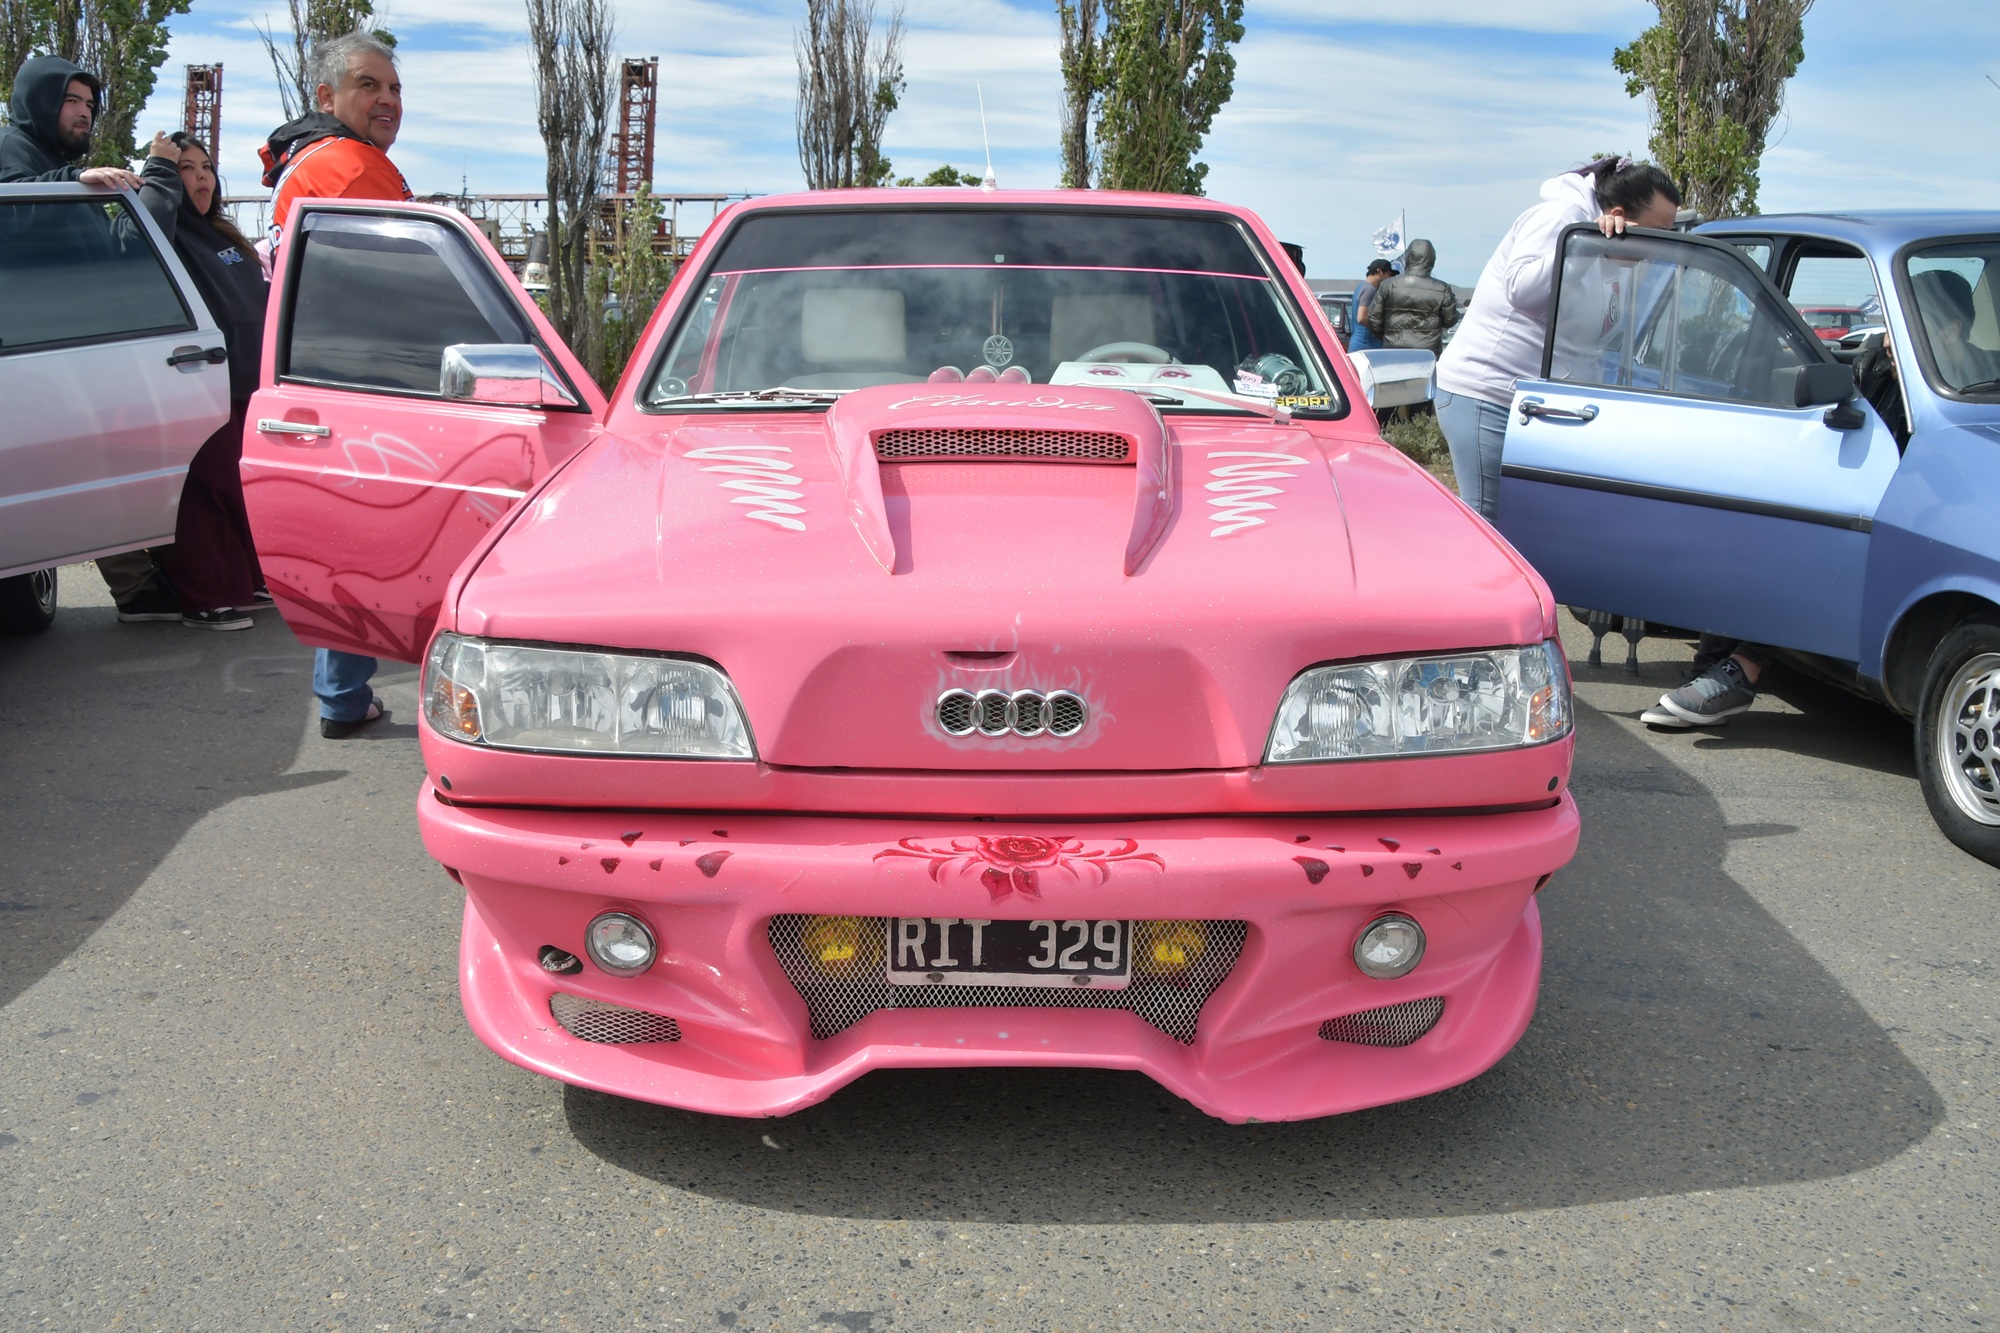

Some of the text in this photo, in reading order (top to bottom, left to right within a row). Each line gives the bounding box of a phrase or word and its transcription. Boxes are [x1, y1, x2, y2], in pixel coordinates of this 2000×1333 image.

[1275, 396, 1330, 407] SPORT
[897, 918, 1122, 970] RIT 329
